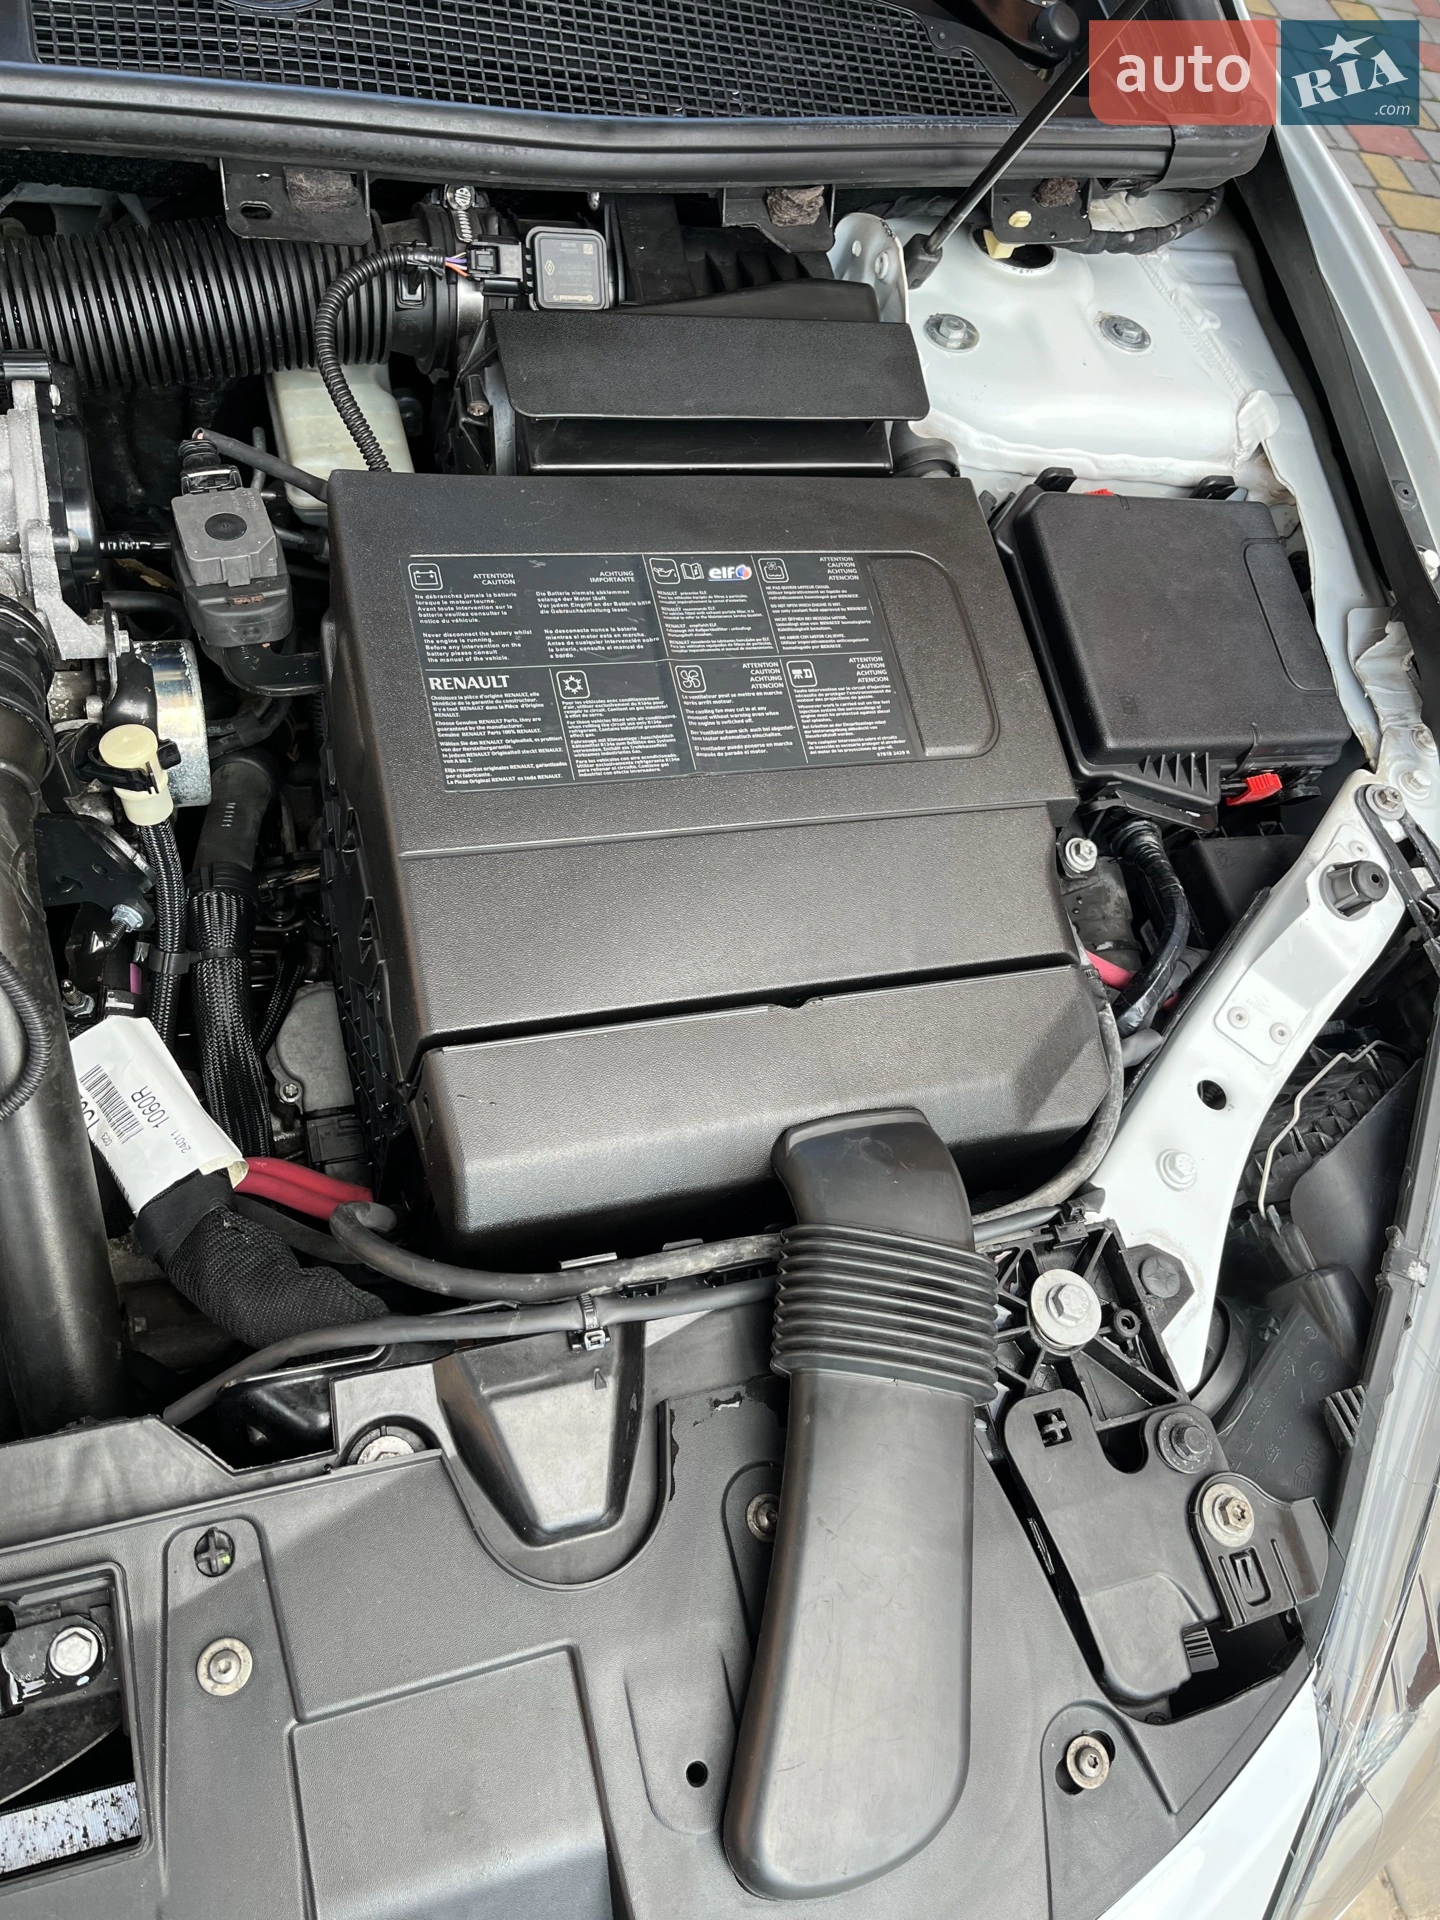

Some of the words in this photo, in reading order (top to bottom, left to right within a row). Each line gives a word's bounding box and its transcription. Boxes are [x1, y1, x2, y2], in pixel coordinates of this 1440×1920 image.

[708, 567, 735, 578] elf
[429, 675, 510, 690] RENAULT
[131, 1085, 169, 1128] 1060R
[171, 1130, 191, 1154] 24011
